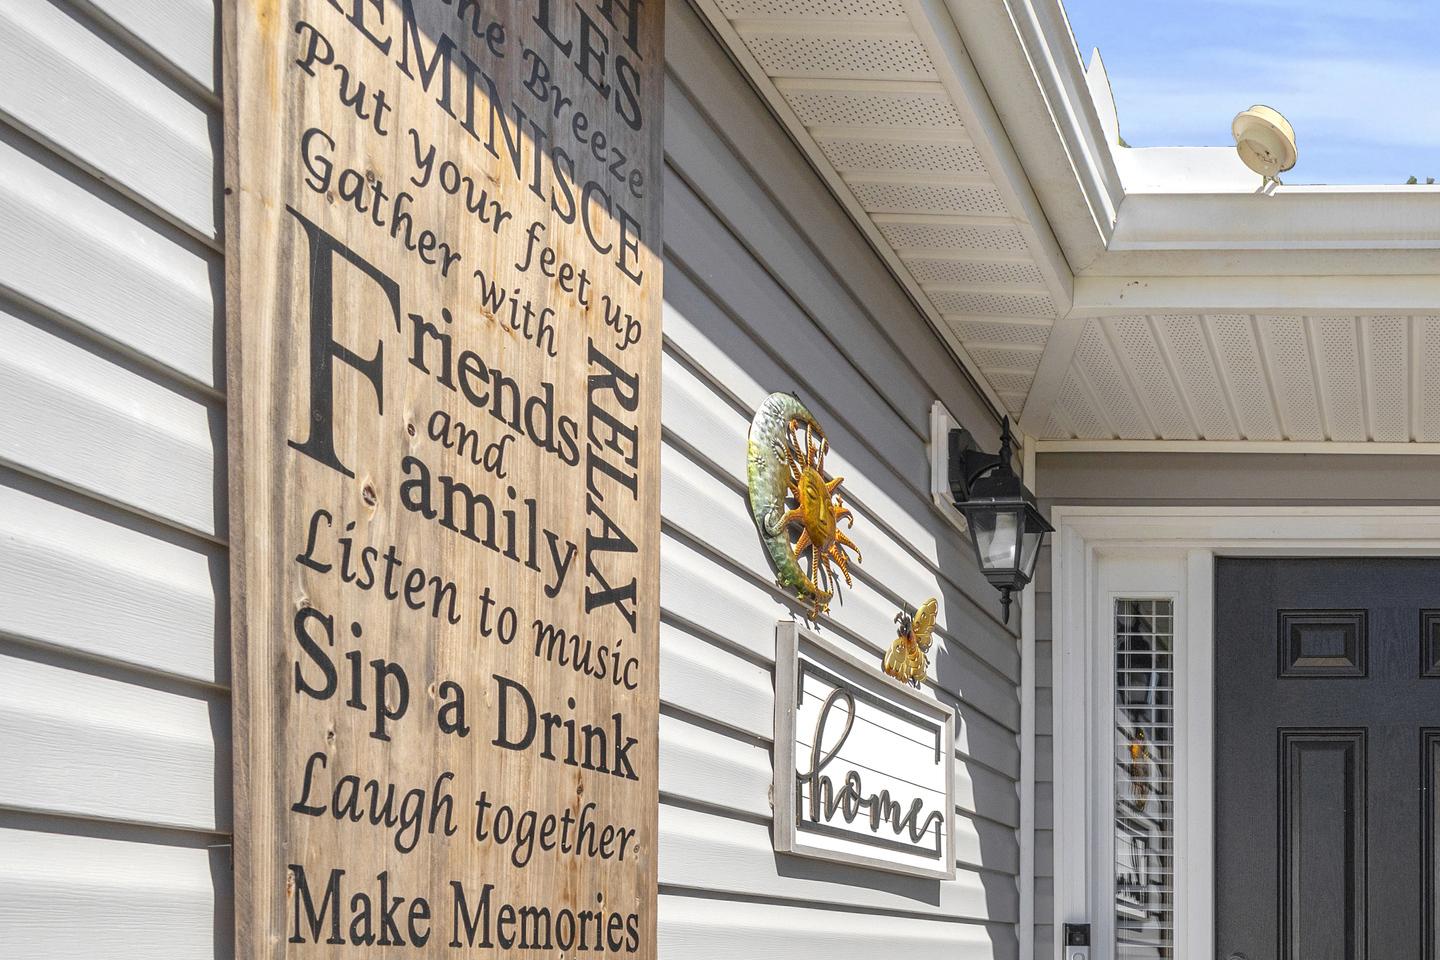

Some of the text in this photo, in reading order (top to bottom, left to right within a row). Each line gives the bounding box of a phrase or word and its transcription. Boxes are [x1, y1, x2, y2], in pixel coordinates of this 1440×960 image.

[295, 21, 642, 350] Put your feet up
[327, 0, 643, 286] EMINISCE
[447, 0, 505, 58] he
[523, 49, 644, 199] Breeze
[301, 128, 557, 357] Gather with
[428, 410, 516, 479] and
[587, 337, 640, 633] RELAX
[295, 509, 639, 690] Listen to music
[294, 607, 639, 781] Sip a Drink
[796, 686, 944, 844] home
[291, 751, 458, 854] Laugh
[287, 864, 640, 953] Make Memories
